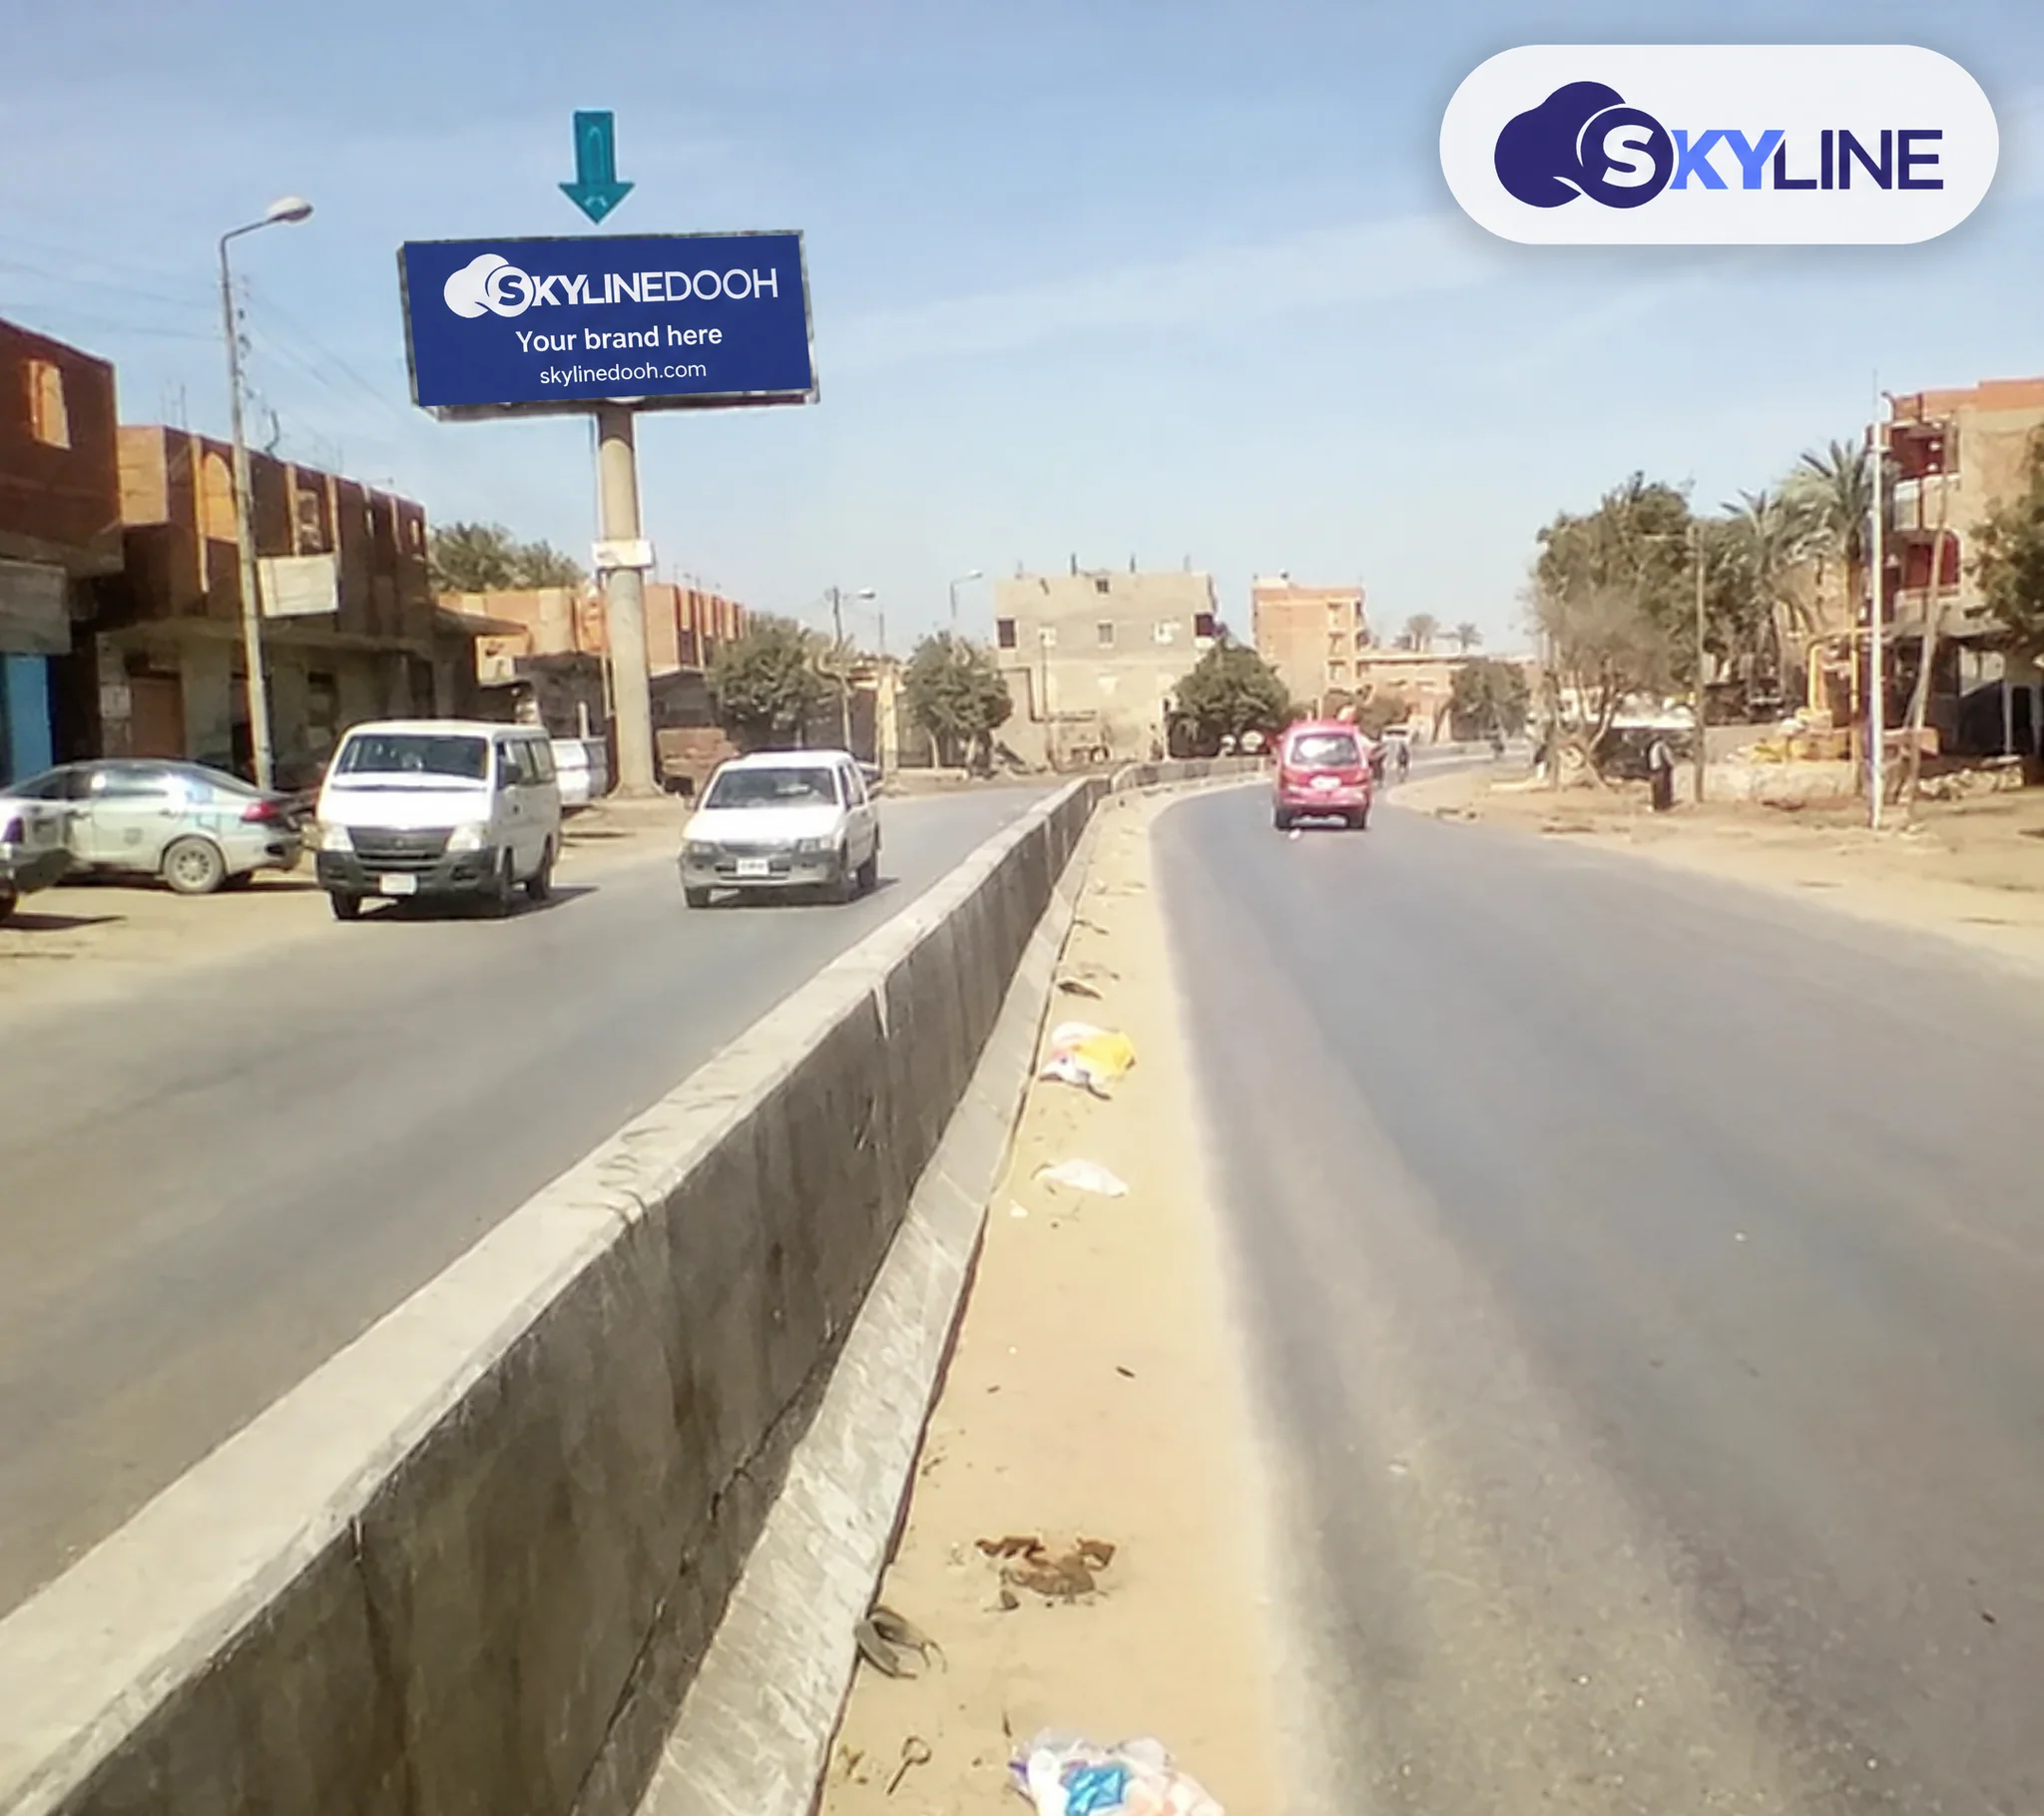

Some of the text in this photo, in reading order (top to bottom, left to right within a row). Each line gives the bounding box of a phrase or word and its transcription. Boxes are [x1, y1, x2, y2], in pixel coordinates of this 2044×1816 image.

[497, 267, 778, 307] SKYLINEDOOH
[515, 324, 724, 353] Your brand here
[539, 361, 708, 387] skylinedooh.com
